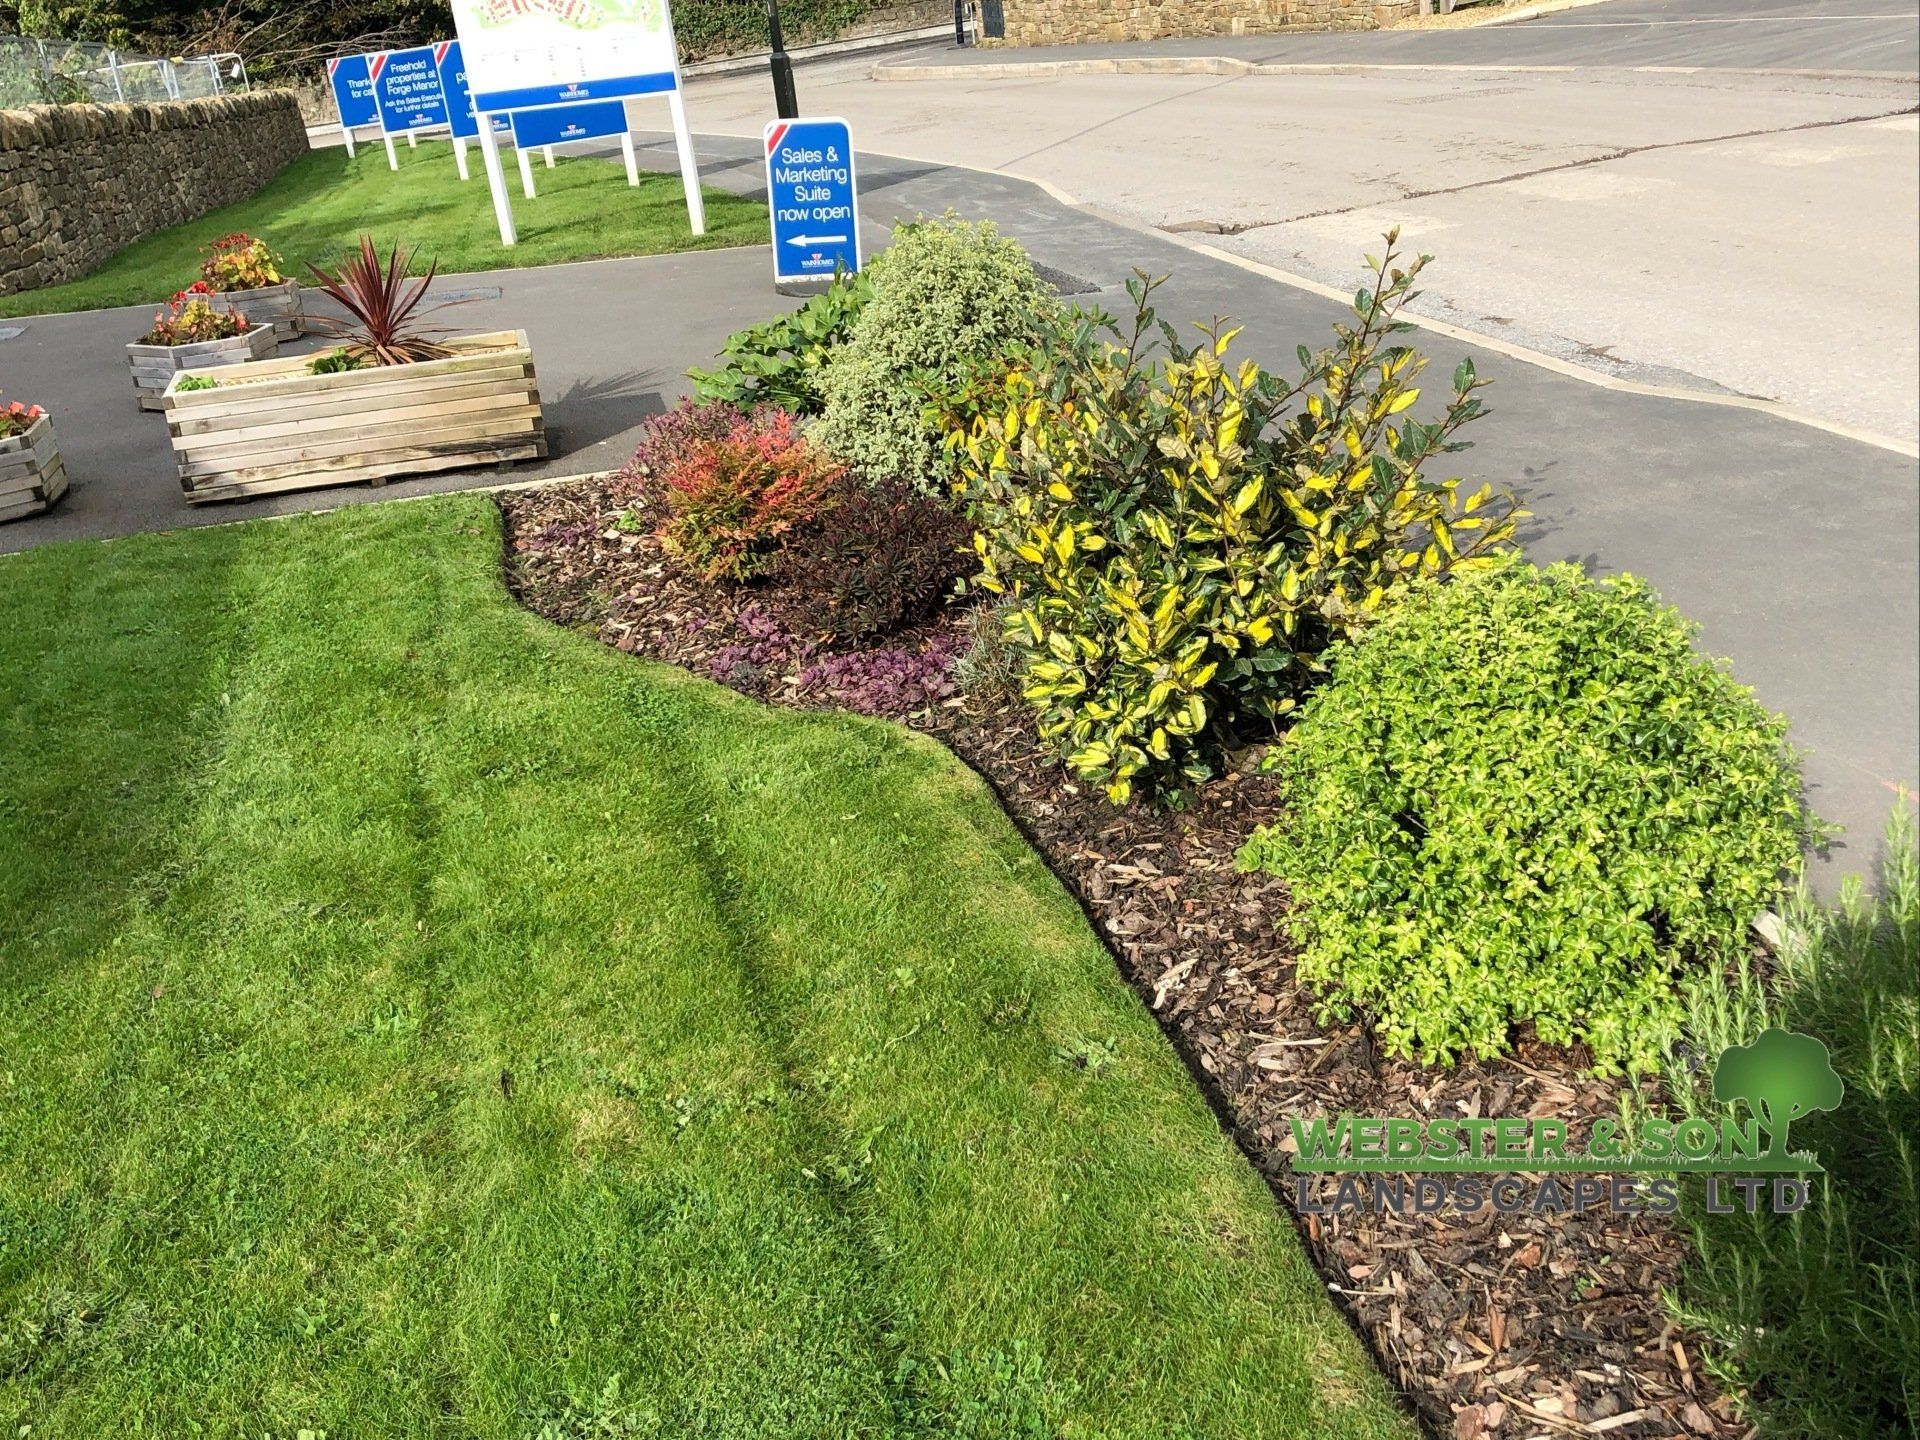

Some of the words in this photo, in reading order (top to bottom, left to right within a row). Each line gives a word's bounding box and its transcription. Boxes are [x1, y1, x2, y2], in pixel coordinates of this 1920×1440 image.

[390, 60, 427, 73] Freehold
[386, 72, 426, 87] properties
[427, 70, 437, 78] at
[351, 89, 362, 99] for
[387, 84, 411, 95] Forge
[412, 80, 439, 91] Manor
[781, 147, 822, 164] Sales
[826, 146, 839, 162] &
[775, 166, 848, 184] Marketing
[794, 185, 831, 202] Suite
[777, 208, 810, 222] now
[812, 206, 851, 223] open
